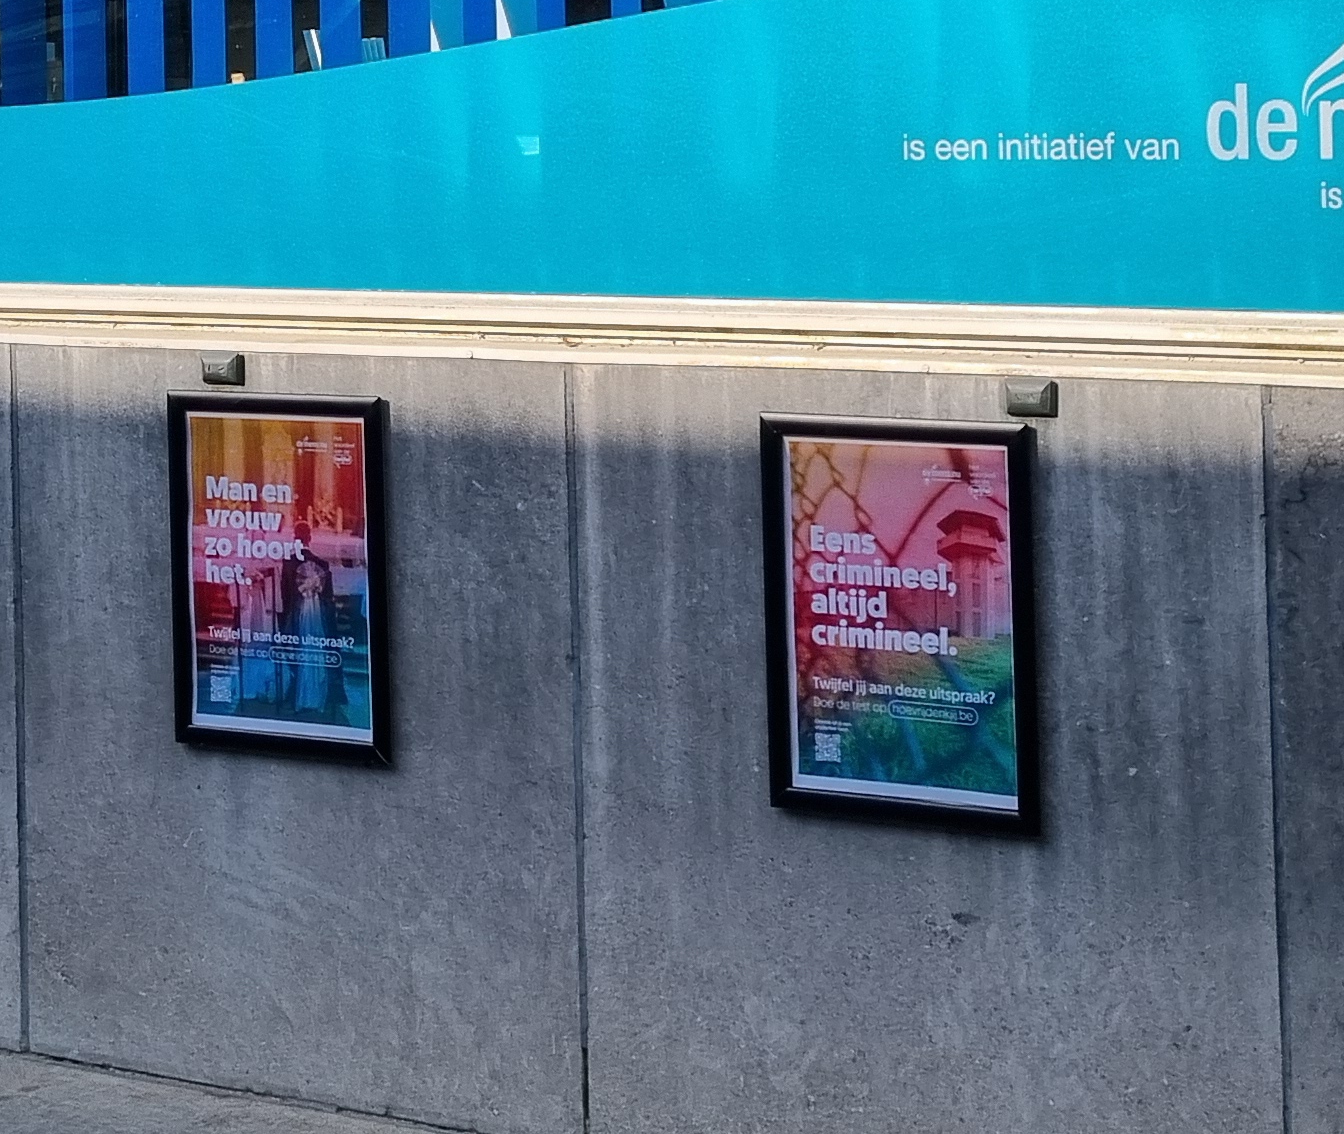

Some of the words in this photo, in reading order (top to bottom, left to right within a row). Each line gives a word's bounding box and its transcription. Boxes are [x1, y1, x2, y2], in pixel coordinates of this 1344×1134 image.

[902, 134, 926, 162] is
[934, 138, 988, 163] een
[997, 131, 1116, 163] initiatief
[1124, 138, 1181, 162] van
[1320, 181, 1343, 212] is
[205, 475, 257, 502] Man
[260, 484, 292, 505] en
[205, 507, 282, 532] vrouw
[205, 537, 232, 558] zo
[236, 533, 305, 562] hoort
[809, 524, 877, 555] Eens
[206, 562, 252, 586] het.
[810, 557, 957, 598] crimineel,
[810, 587, 888, 622] altijd
[208, 625, 240, 642] Twijfel
[253, 632, 272, 642] aan
[273, 631, 300, 645] deze
[301, 633, 355, 649] uitspraak?
[811, 620, 958, 657] crimineel.
[812, 676, 853, 694] Twijfel
[855, 679, 867, 696] jij
[869, 683, 892, 696] aan
[894, 683, 927, 699] deze
[929, 686, 996, 705] uitspraak?
[813, 696, 835, 708] Doe
[836, 697, 850, 710] de
[872, 702, 888, 715] op
